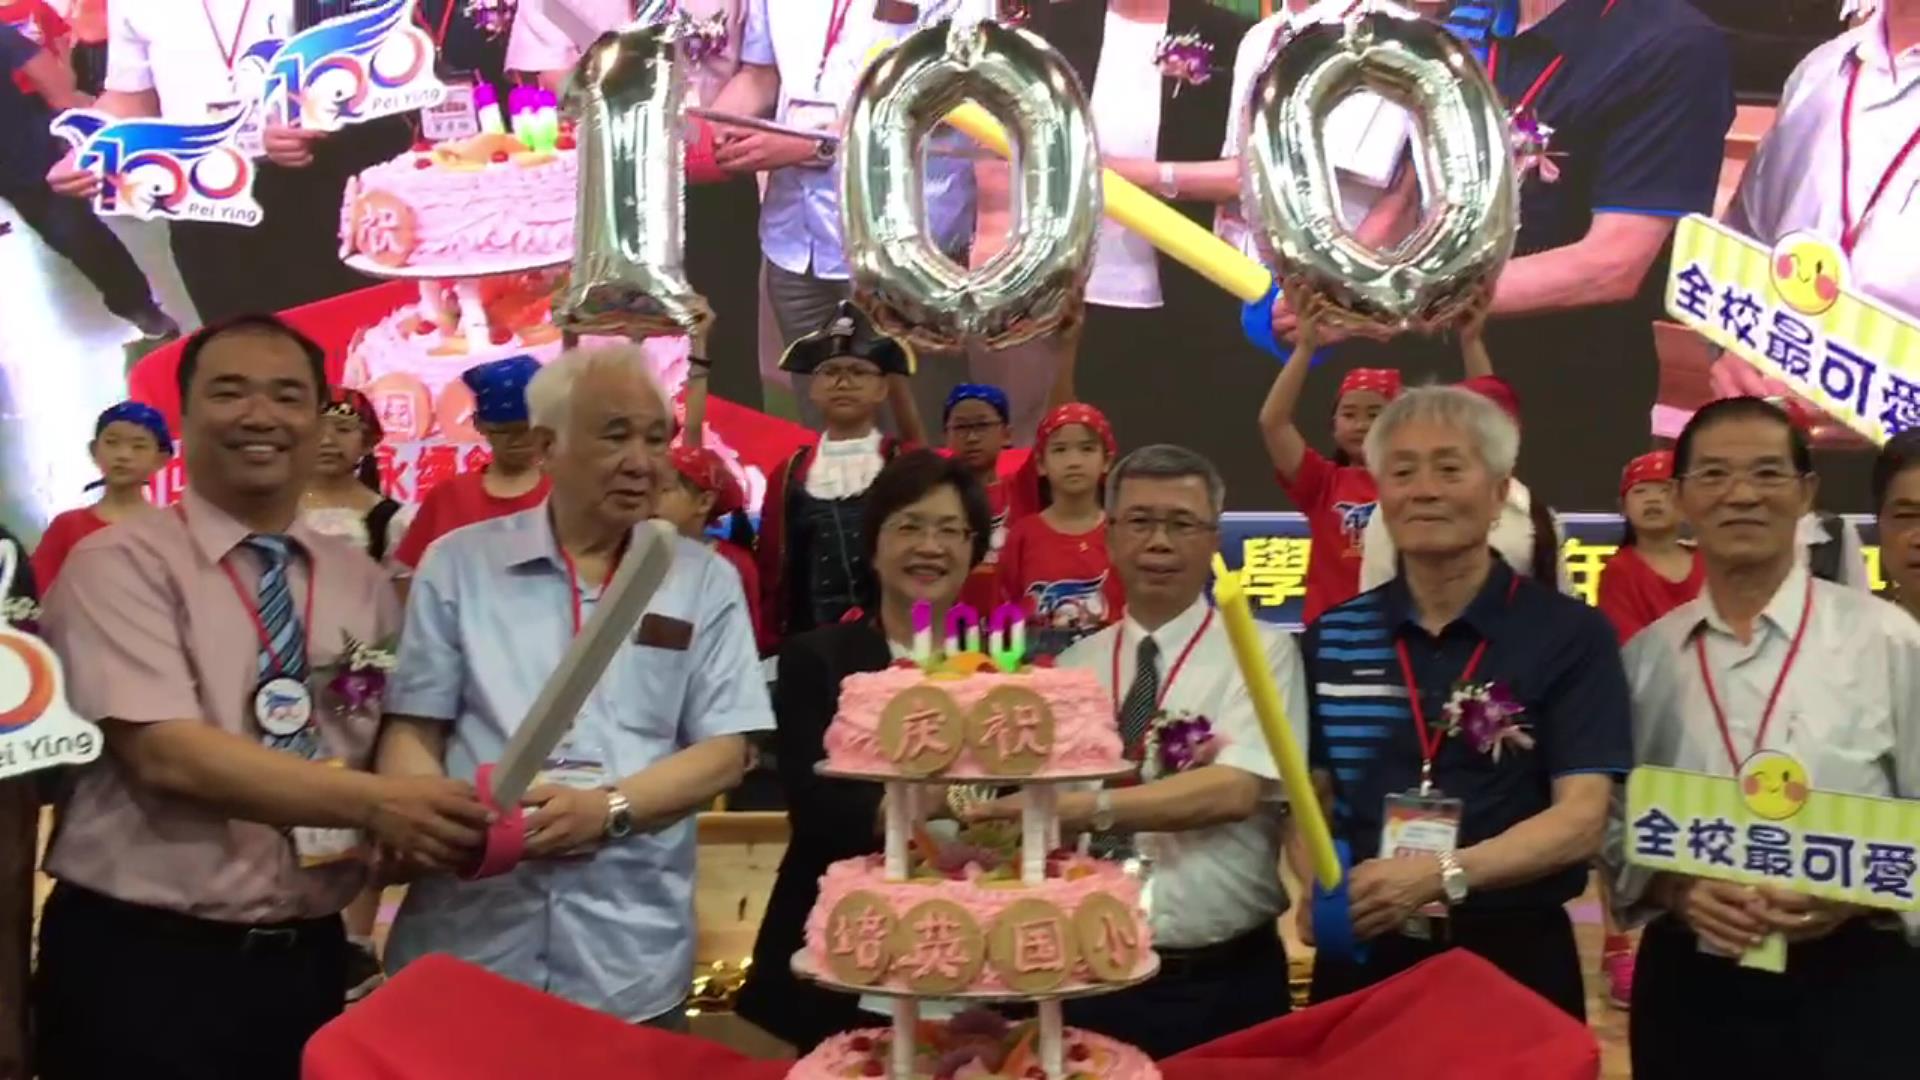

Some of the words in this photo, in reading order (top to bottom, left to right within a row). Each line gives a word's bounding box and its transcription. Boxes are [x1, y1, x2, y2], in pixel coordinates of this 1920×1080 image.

[188, 203, 216, 217] Pei
[220, 205, 258, 223] Ying
[556, 14, 1520, 348] 100
[1243, 537, 1312, 606] 學
[912, 600, 1027, 672] 100
[24, 731, 94, 760] Ying
[898, 707, 1049, 761] 庆祝
[1633, 807, 1918, 899] 全校最可愛
[833, 907, 1137, 977] 培英国小
